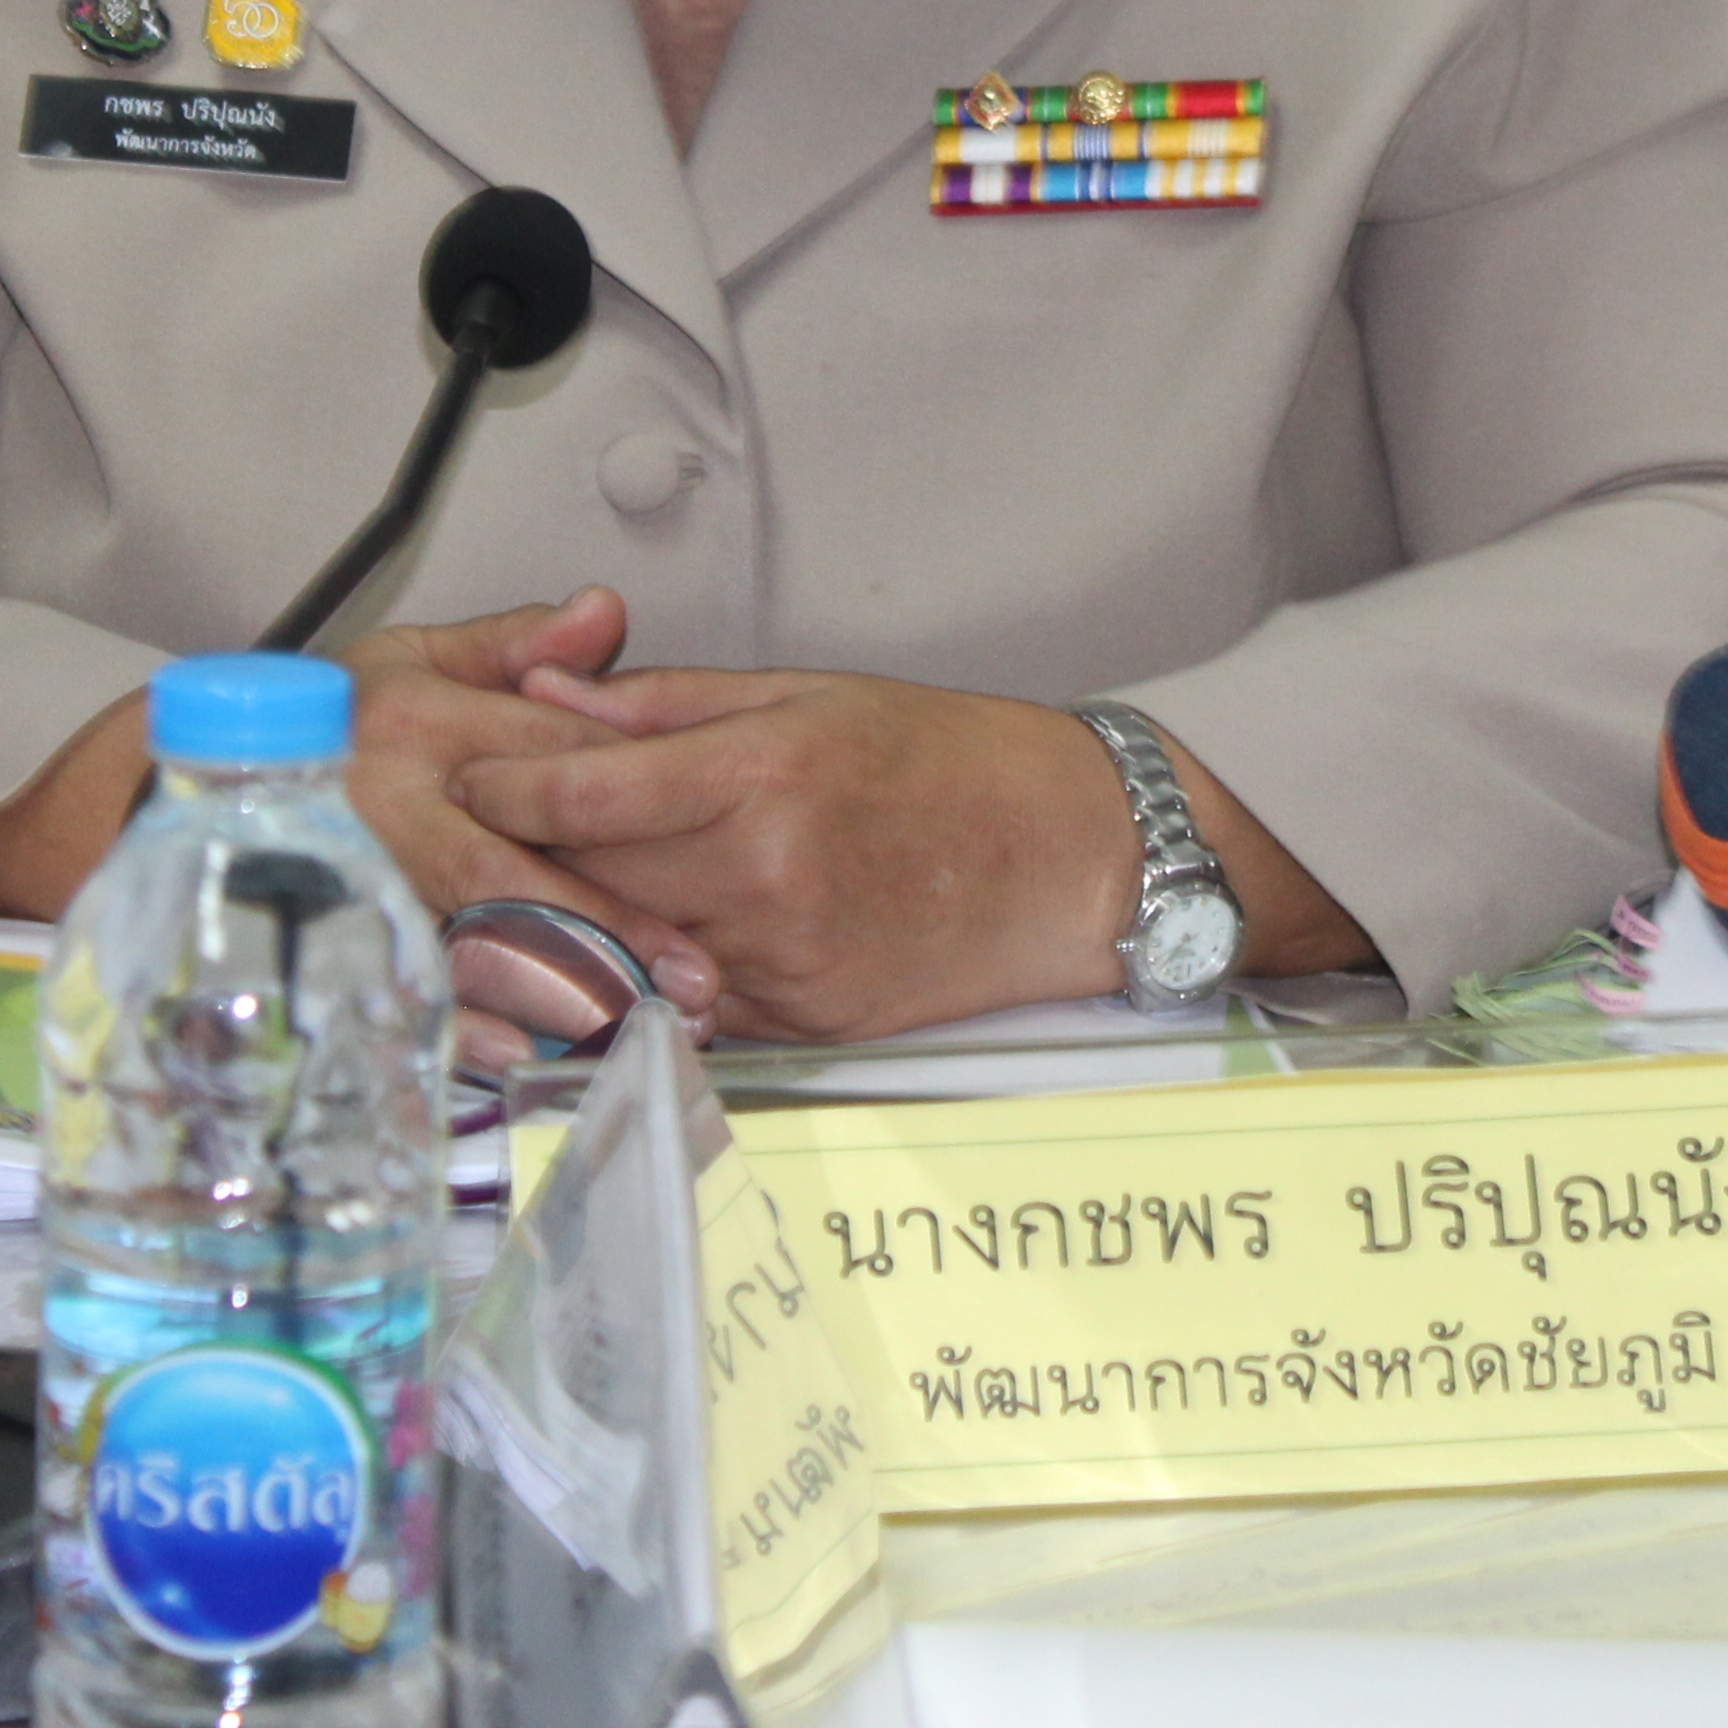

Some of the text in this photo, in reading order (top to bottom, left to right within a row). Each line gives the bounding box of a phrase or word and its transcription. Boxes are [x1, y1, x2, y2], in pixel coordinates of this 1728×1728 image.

[104, 94, 277, 130] กชพร ปริปุณนัง
[114, 128, 257, 159] พัฒนาการจังหวัด
[822, 1189, 1273, 1279] นางกชพร
[908, 1310, 1718, 1423] พัฒนาการจังหวัดชัยภูมิ
